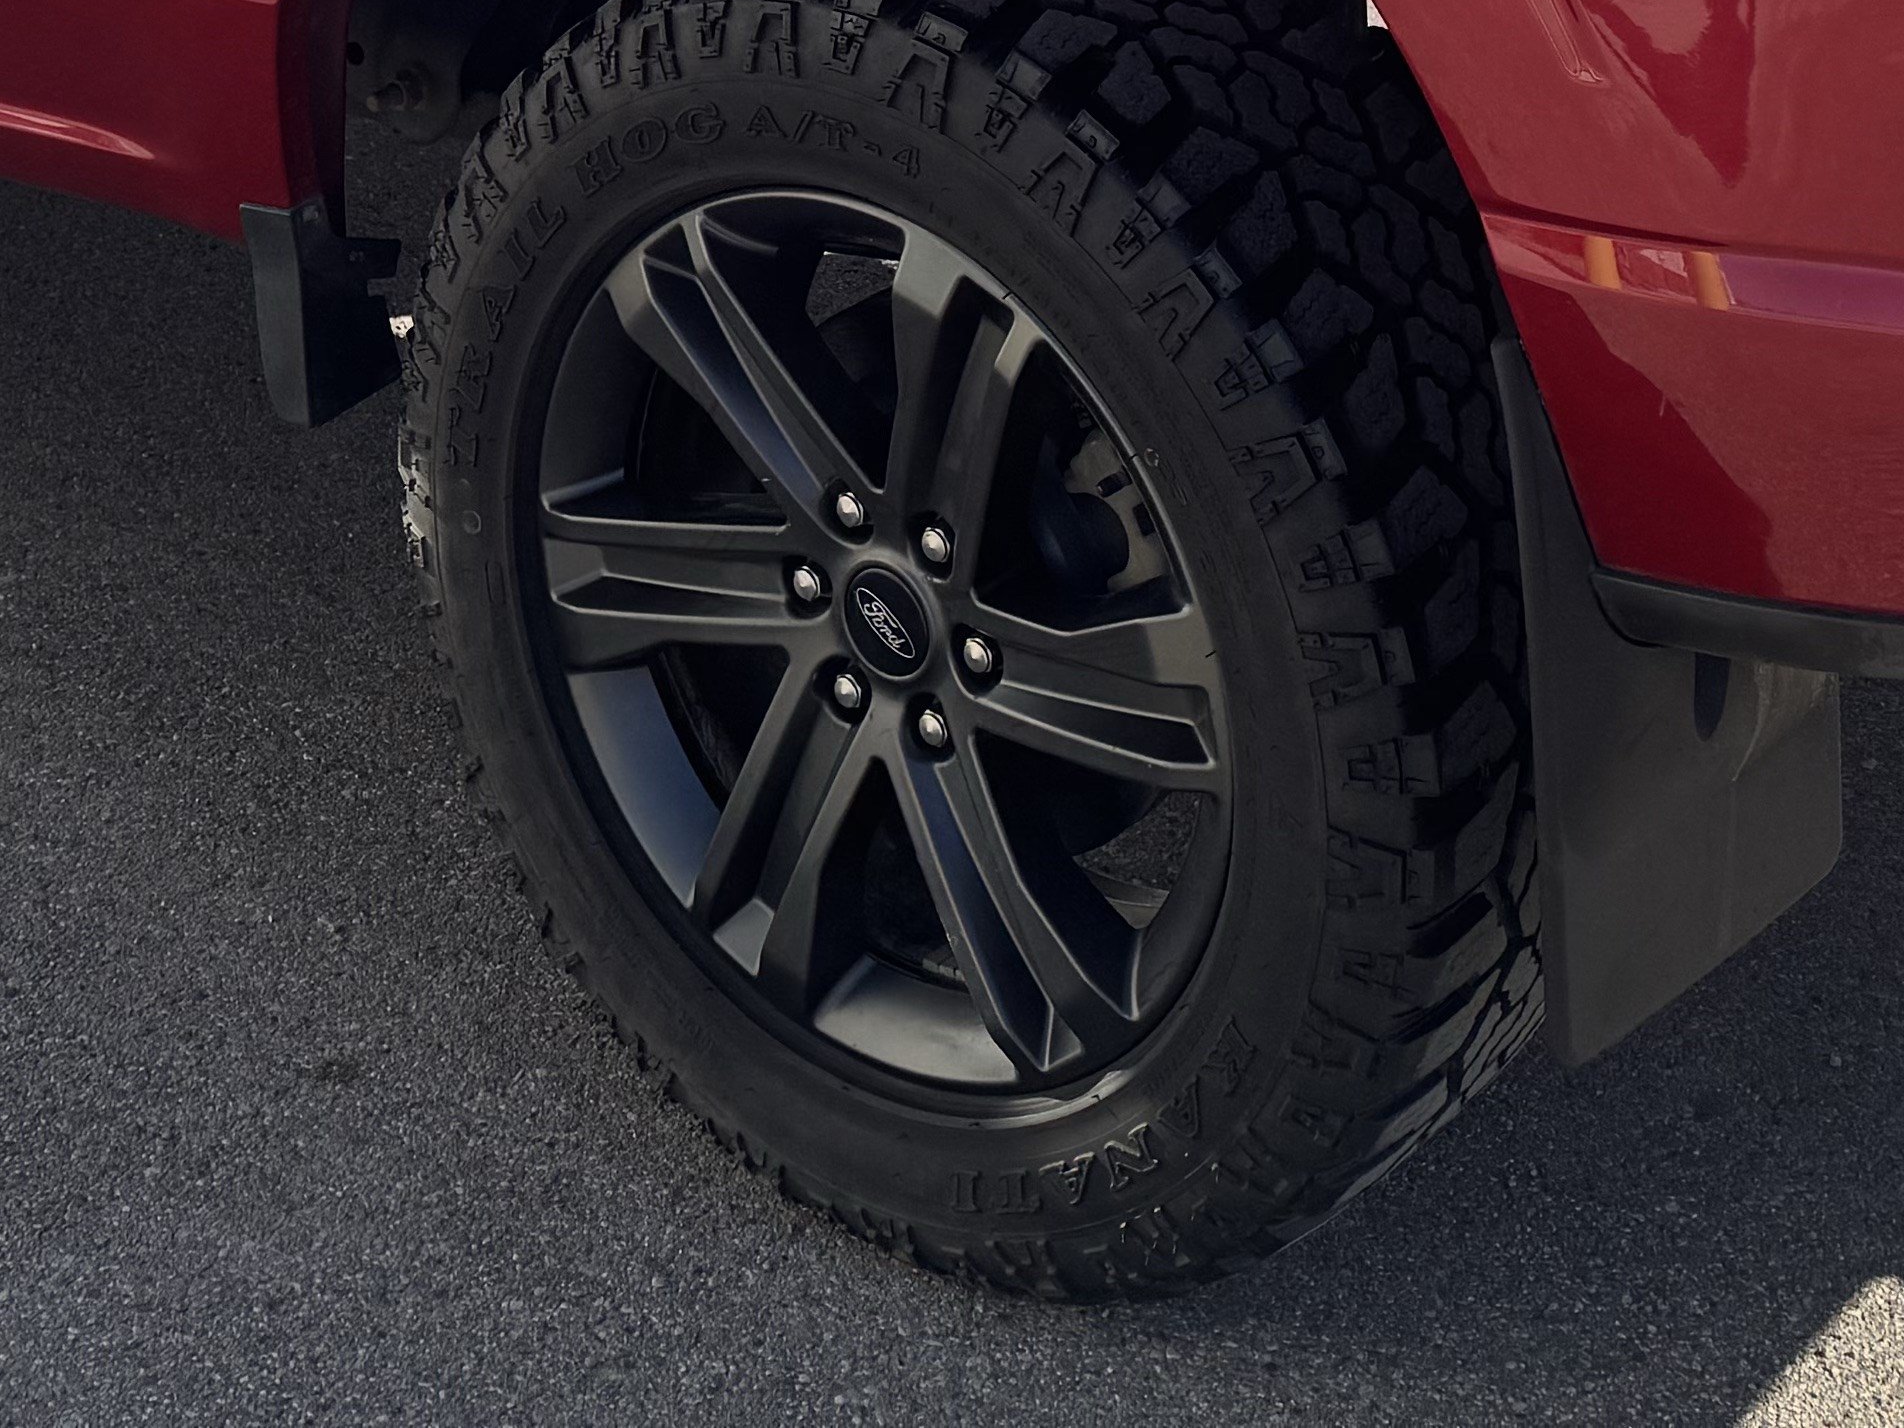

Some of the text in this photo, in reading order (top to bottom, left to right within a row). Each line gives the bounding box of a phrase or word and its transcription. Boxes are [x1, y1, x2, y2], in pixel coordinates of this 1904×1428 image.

[445, 196, 567, 467] TRAIL
[571, 102, 724, 199] HOG
[862, 599, 908, 650] Ford
[950, 1013, 1261, 1215] KANATI
